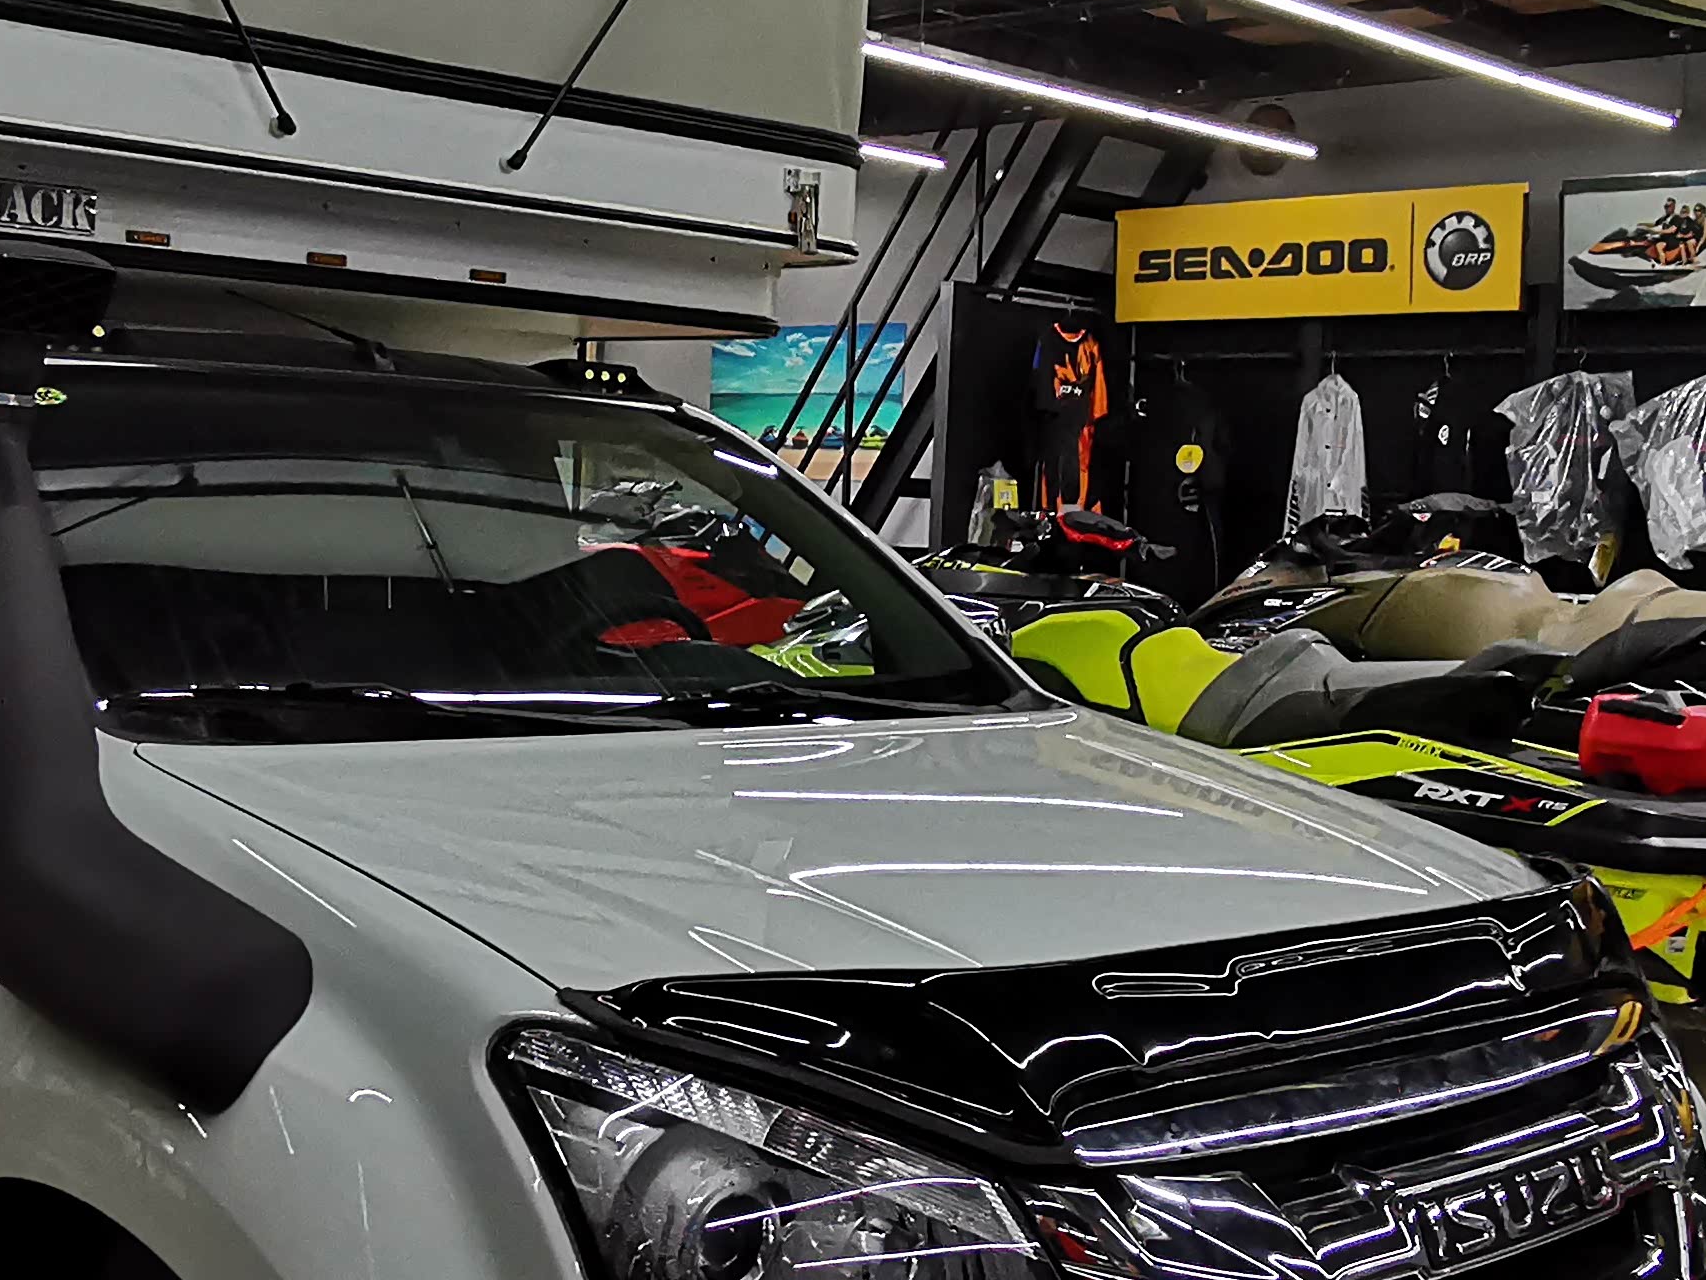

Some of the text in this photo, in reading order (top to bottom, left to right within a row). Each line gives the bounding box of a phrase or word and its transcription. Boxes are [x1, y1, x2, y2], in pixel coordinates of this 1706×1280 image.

[1450, 251, 1492, 268] BRP
[1414, 780, 1504, 808] RXT
[1500, 795, 1542, 813] X
[1425, 1146, 1615, 1258] ISUZU
